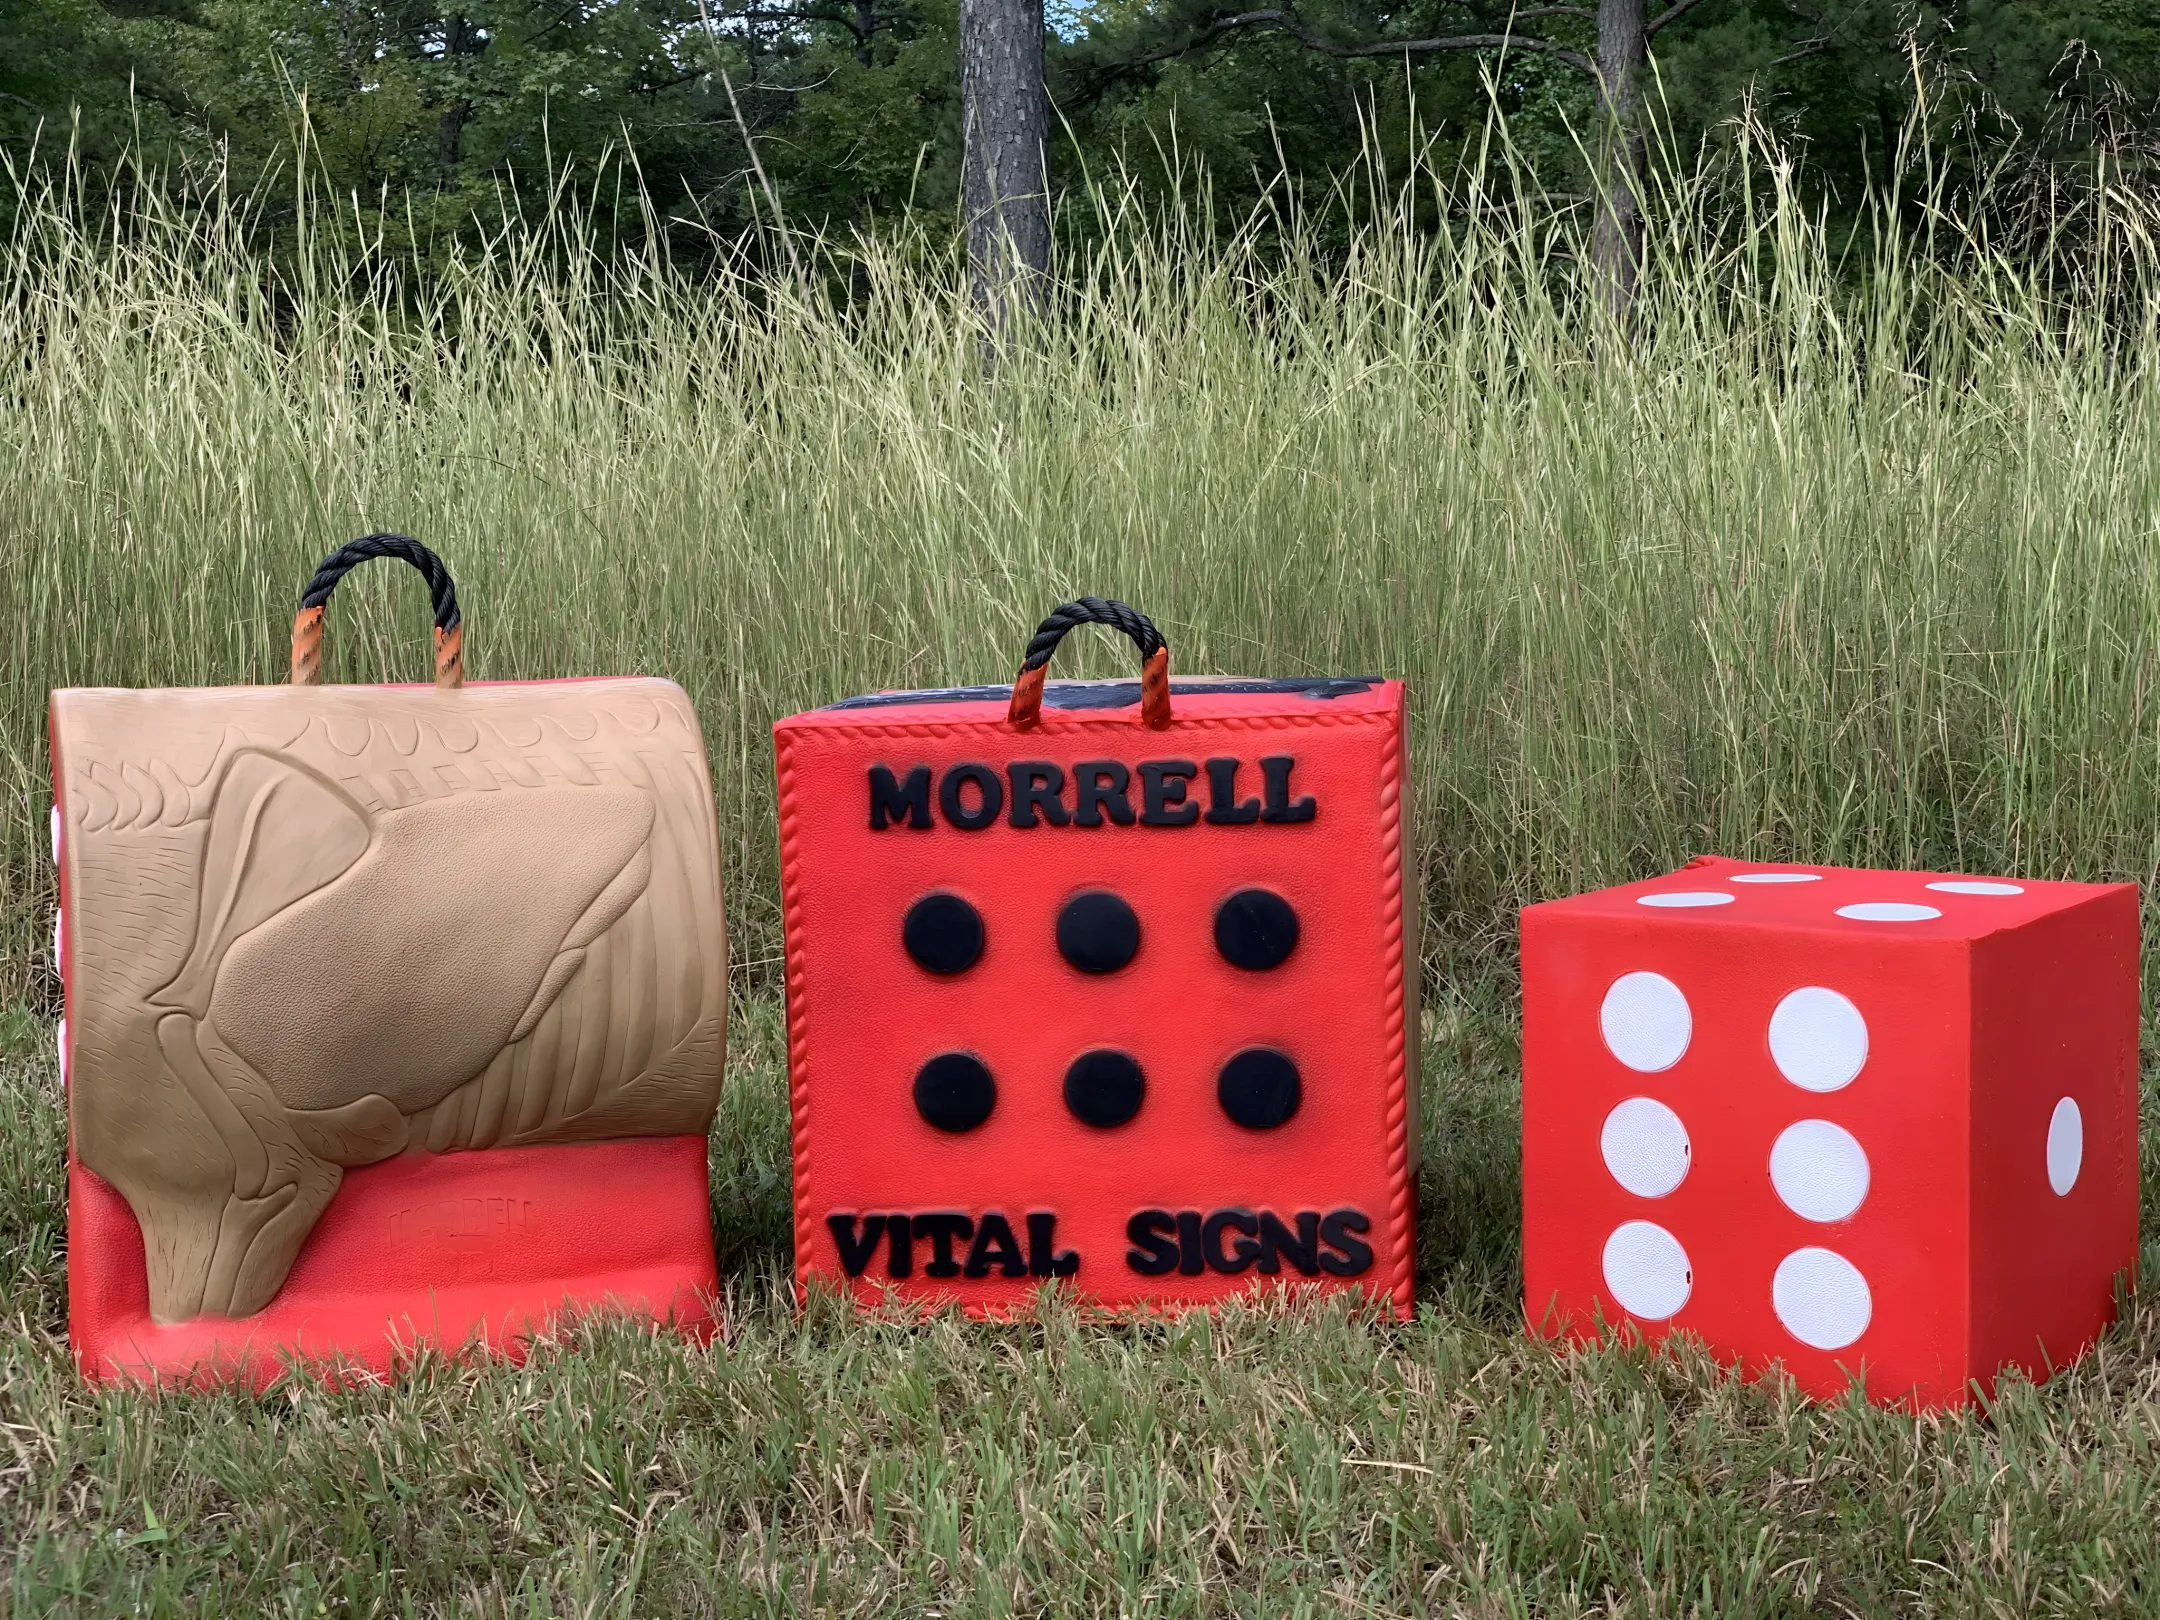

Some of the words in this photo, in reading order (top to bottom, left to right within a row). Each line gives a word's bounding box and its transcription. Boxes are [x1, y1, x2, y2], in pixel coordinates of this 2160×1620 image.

[867, 756, 1318, 832] MORRELL
[826, 1211, 1079, 1278] VITAL
[1125, 1207, 1375, 1278] SIGNS
